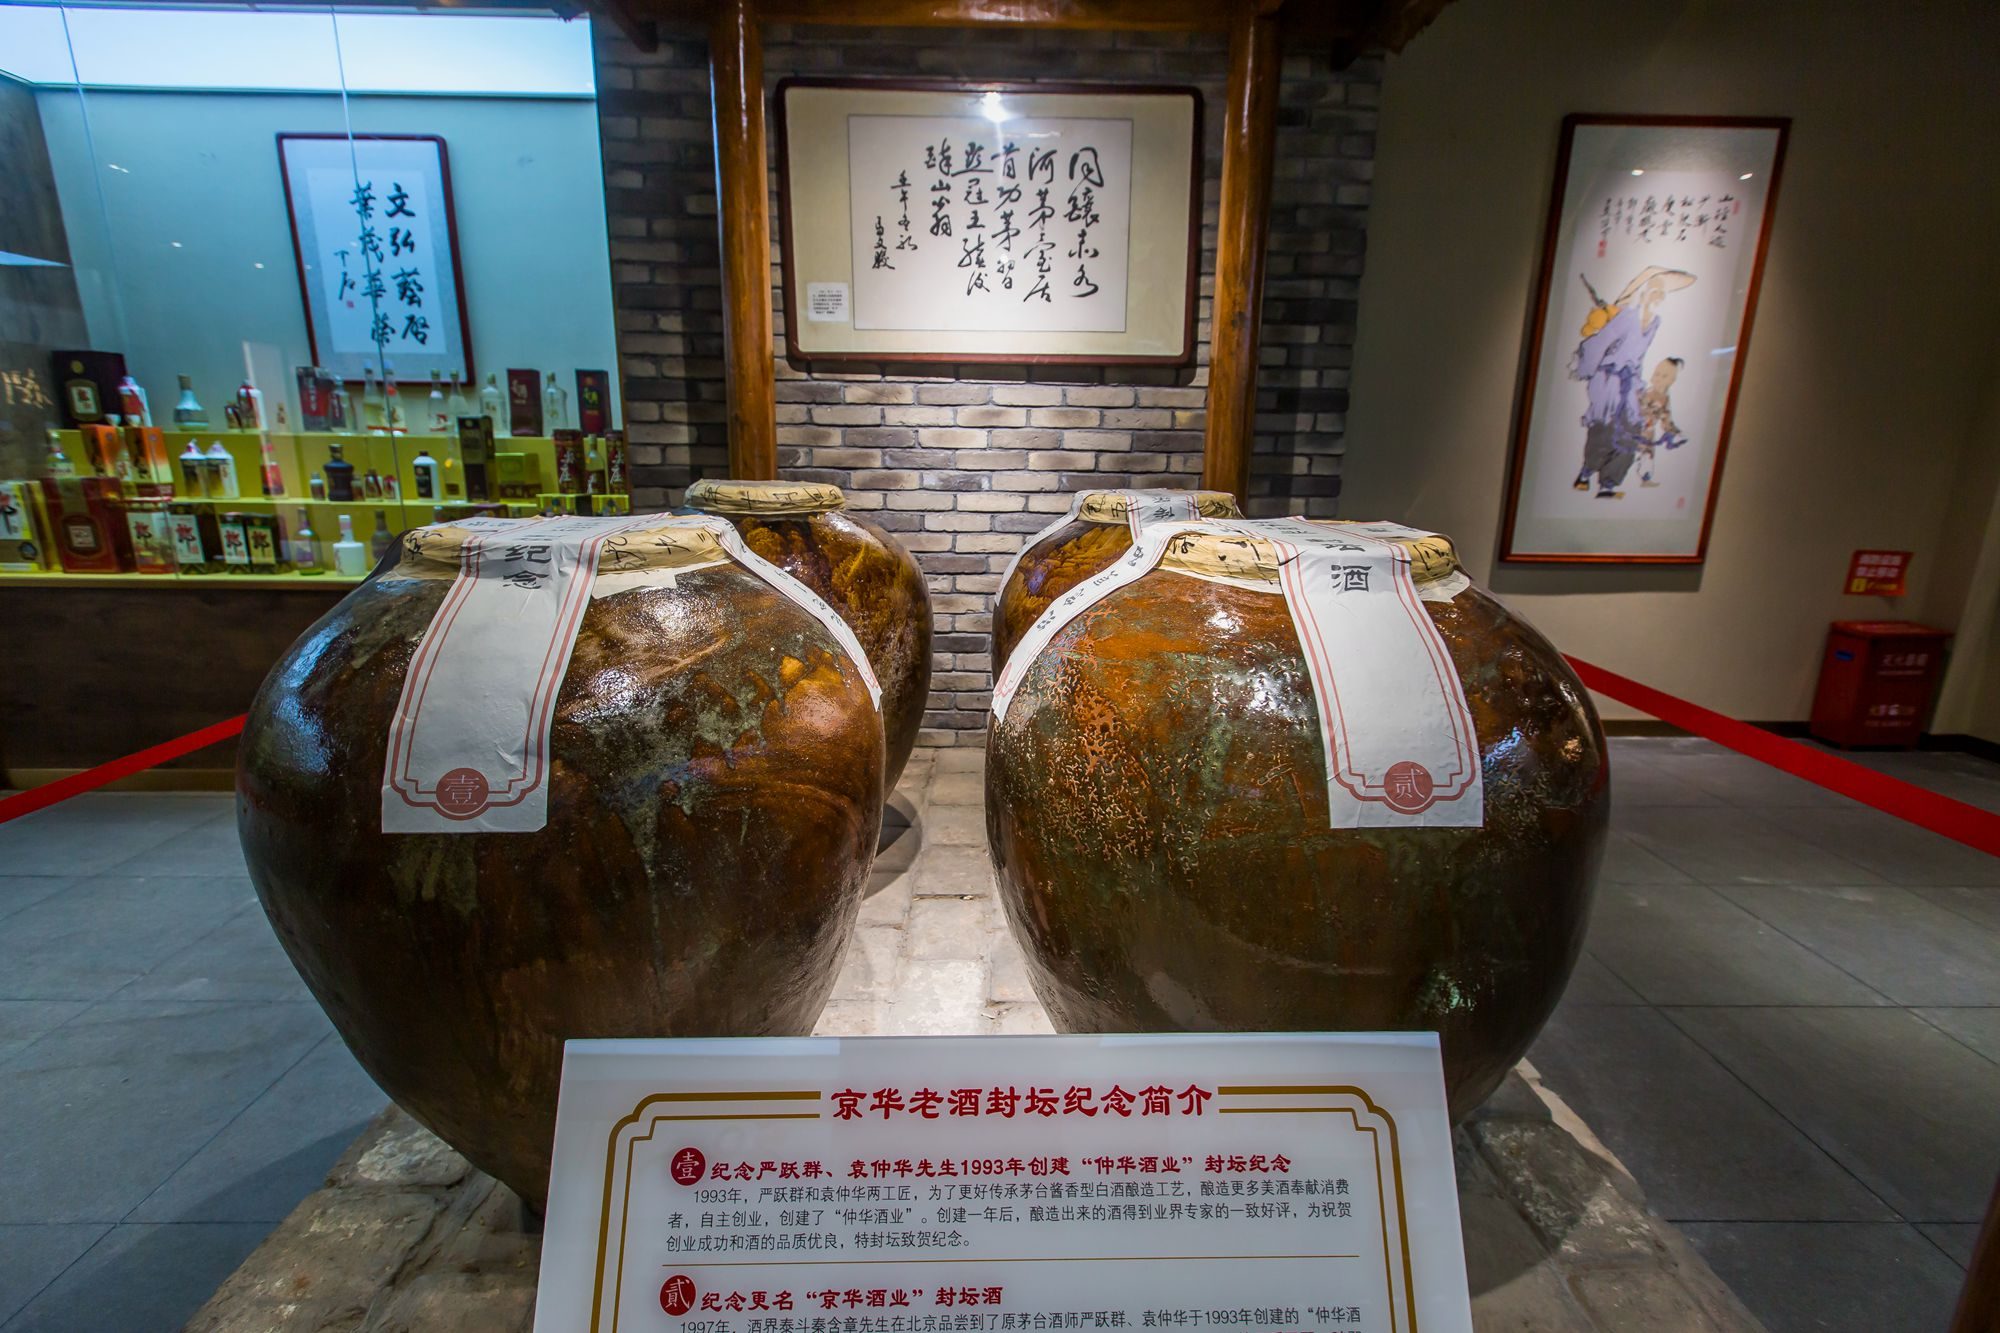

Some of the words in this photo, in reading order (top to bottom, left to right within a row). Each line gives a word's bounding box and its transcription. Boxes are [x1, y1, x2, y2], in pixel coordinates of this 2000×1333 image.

[830, 1084, 1214, 1120] 京华老酒封坛纪念简介
[673, 1150, 702, 1182] 壹
